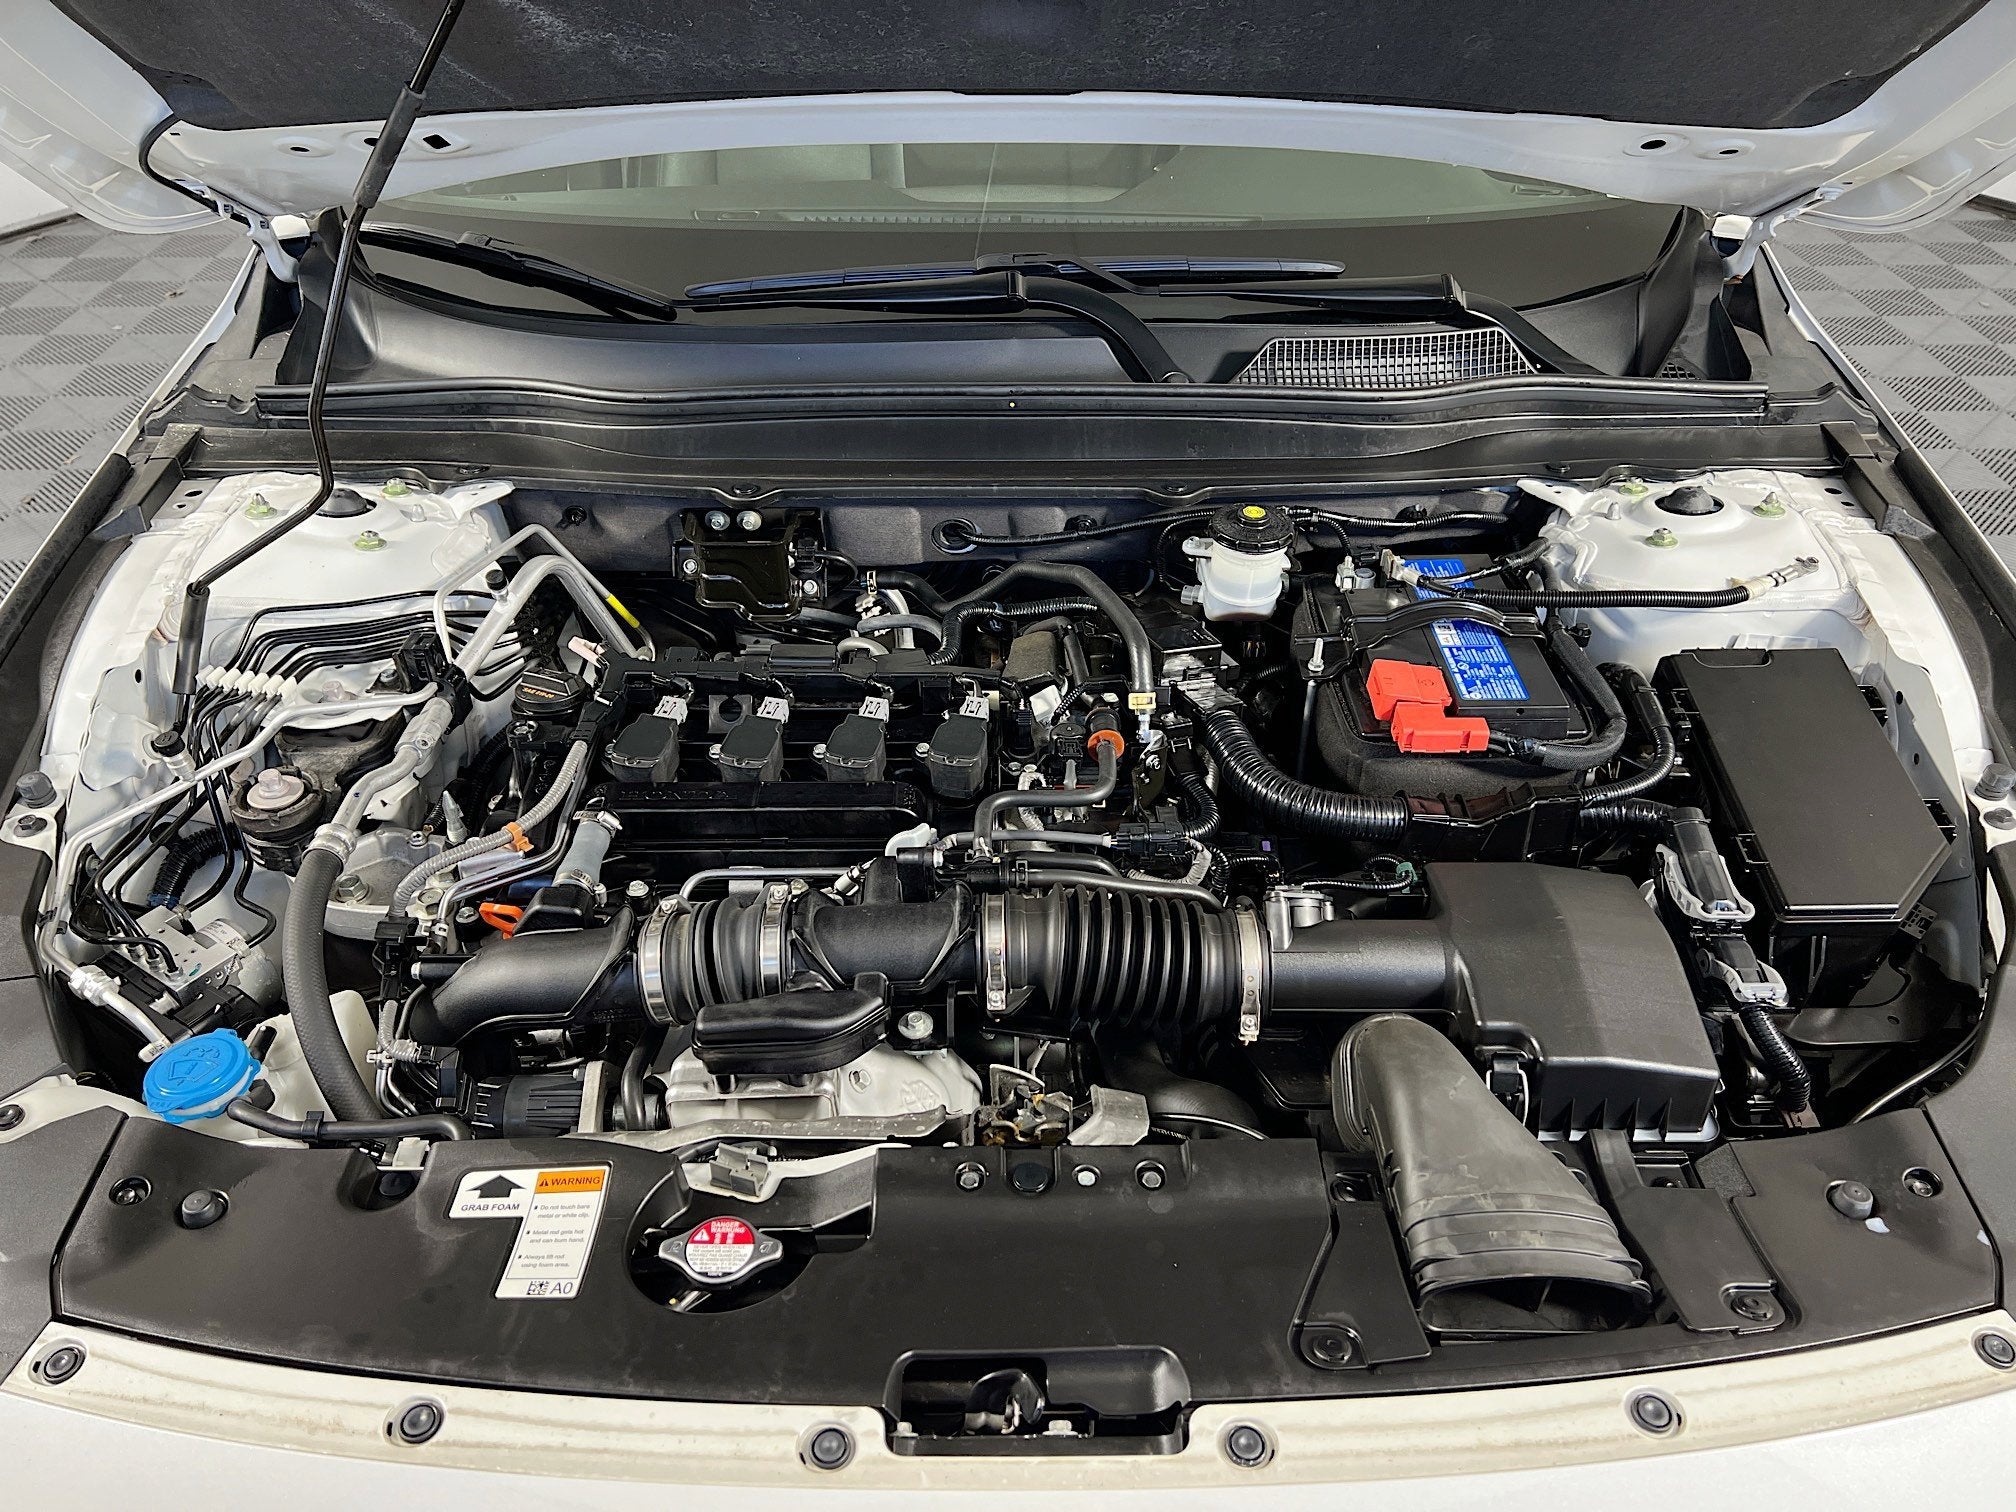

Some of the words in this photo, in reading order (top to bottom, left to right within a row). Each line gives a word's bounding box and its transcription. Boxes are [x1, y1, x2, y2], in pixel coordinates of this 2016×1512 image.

[551, 1177, 601, 1187] WARNING
[460, 1203, 489, 1212] GRAB
[491, 1203, 520, 1211] FOAM
[549, 1281, 574, 1295] A0
